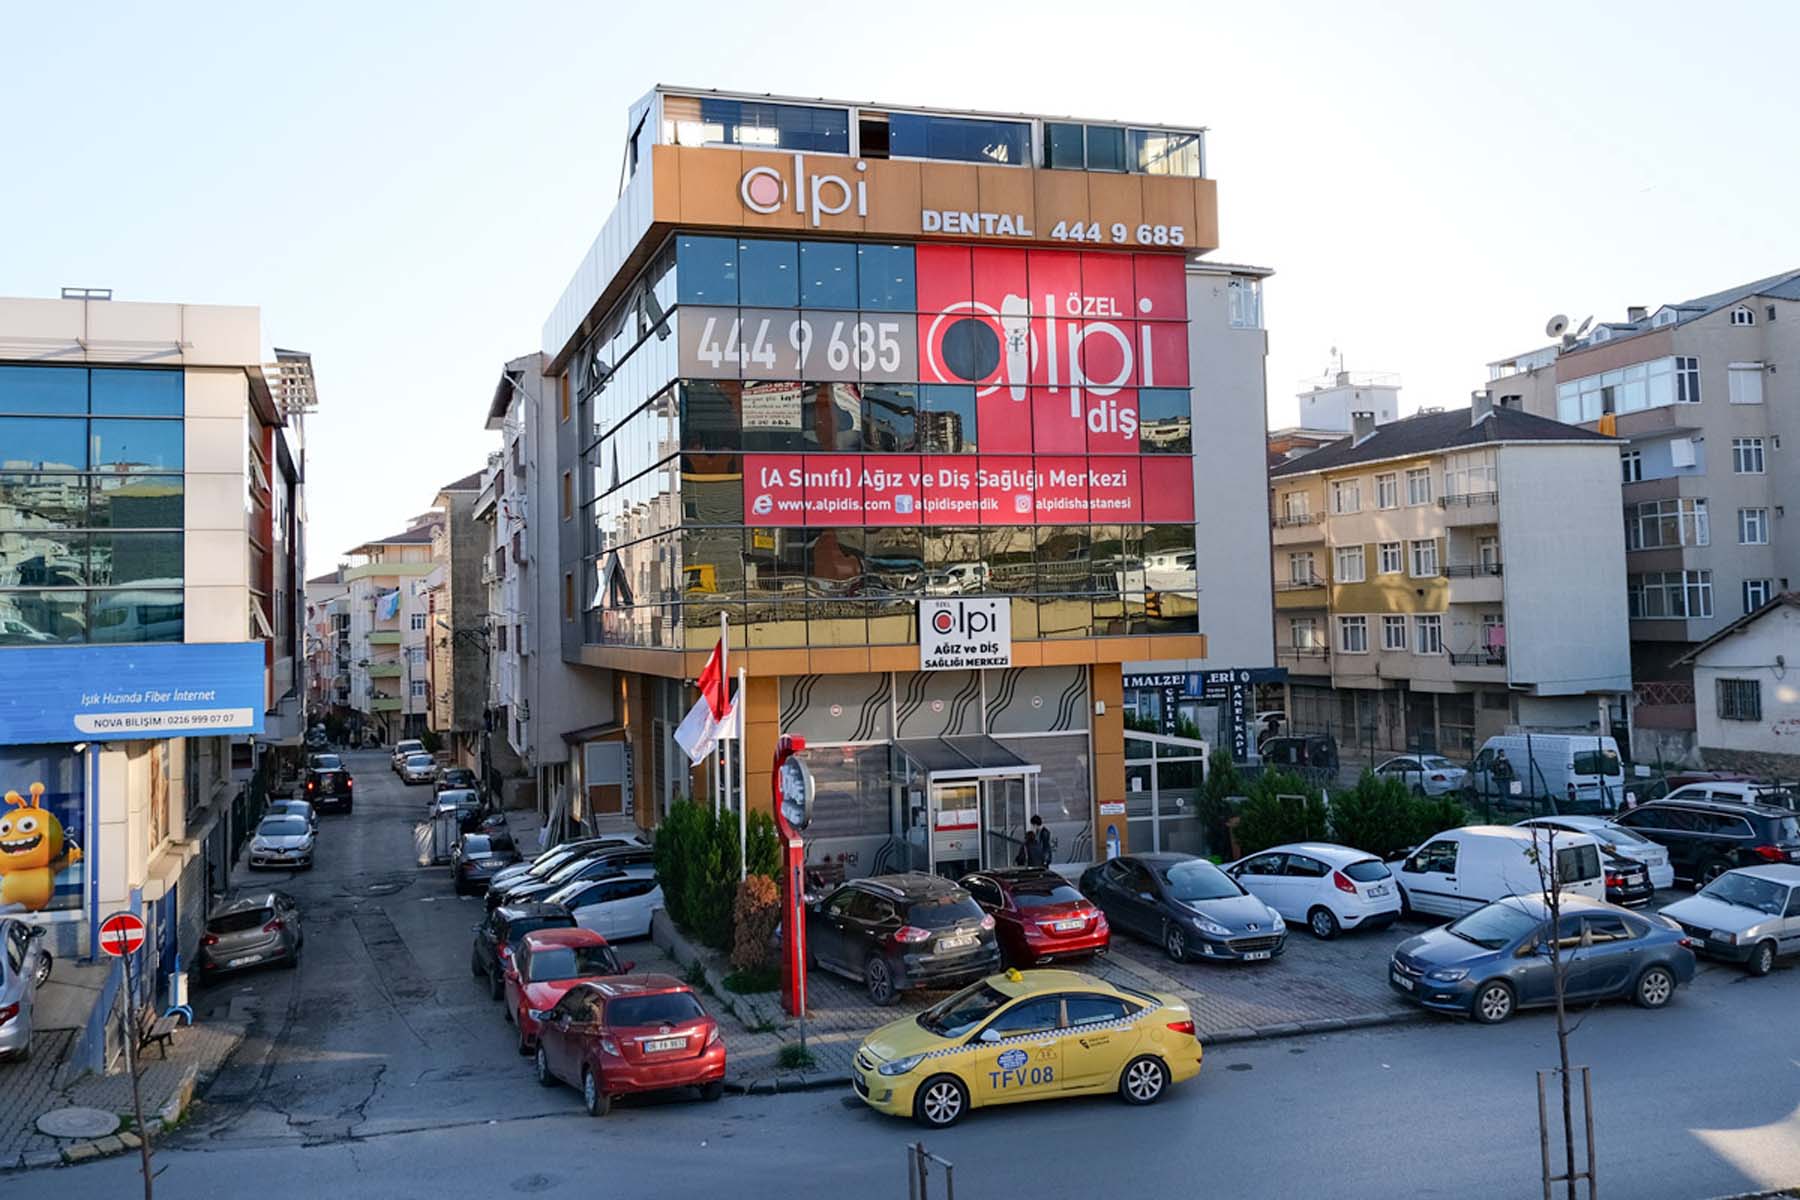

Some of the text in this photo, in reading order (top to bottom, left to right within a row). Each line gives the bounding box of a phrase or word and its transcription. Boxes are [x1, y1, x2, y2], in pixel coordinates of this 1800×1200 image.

[741, 153, 867, 227] alpi
[921, 209, 1185, 246] DENTAL 444 9 685
[1065, 291, 1123, 317] ÖZEL
[696, 316, 901, 373] 444 9 685
[1087, 400, 1137, 439] diş
[760, 467, 1128, 491] (A Sınıfı) Ağız ve Diş Sağlığı Merkezi
[777, 496, 1132, 513] www.alpidis.com alpidispendik alpidishastanesi
[932, 601, 996, 640] alpi
[934, 640, 999, 655] AĞIZ ve DİŞ
[925, 655, 1009, 669] SAĞLIĞI MERKEZİ
[144, 689, 172, 703] Fiber
[93, 718, 123, 729] NOVA
[167, 715, 190, 725] 0216
[191, 714, 209, 724] 999
[210, 713, 222, 723] 07
[223, 712, 234, 722] 07
